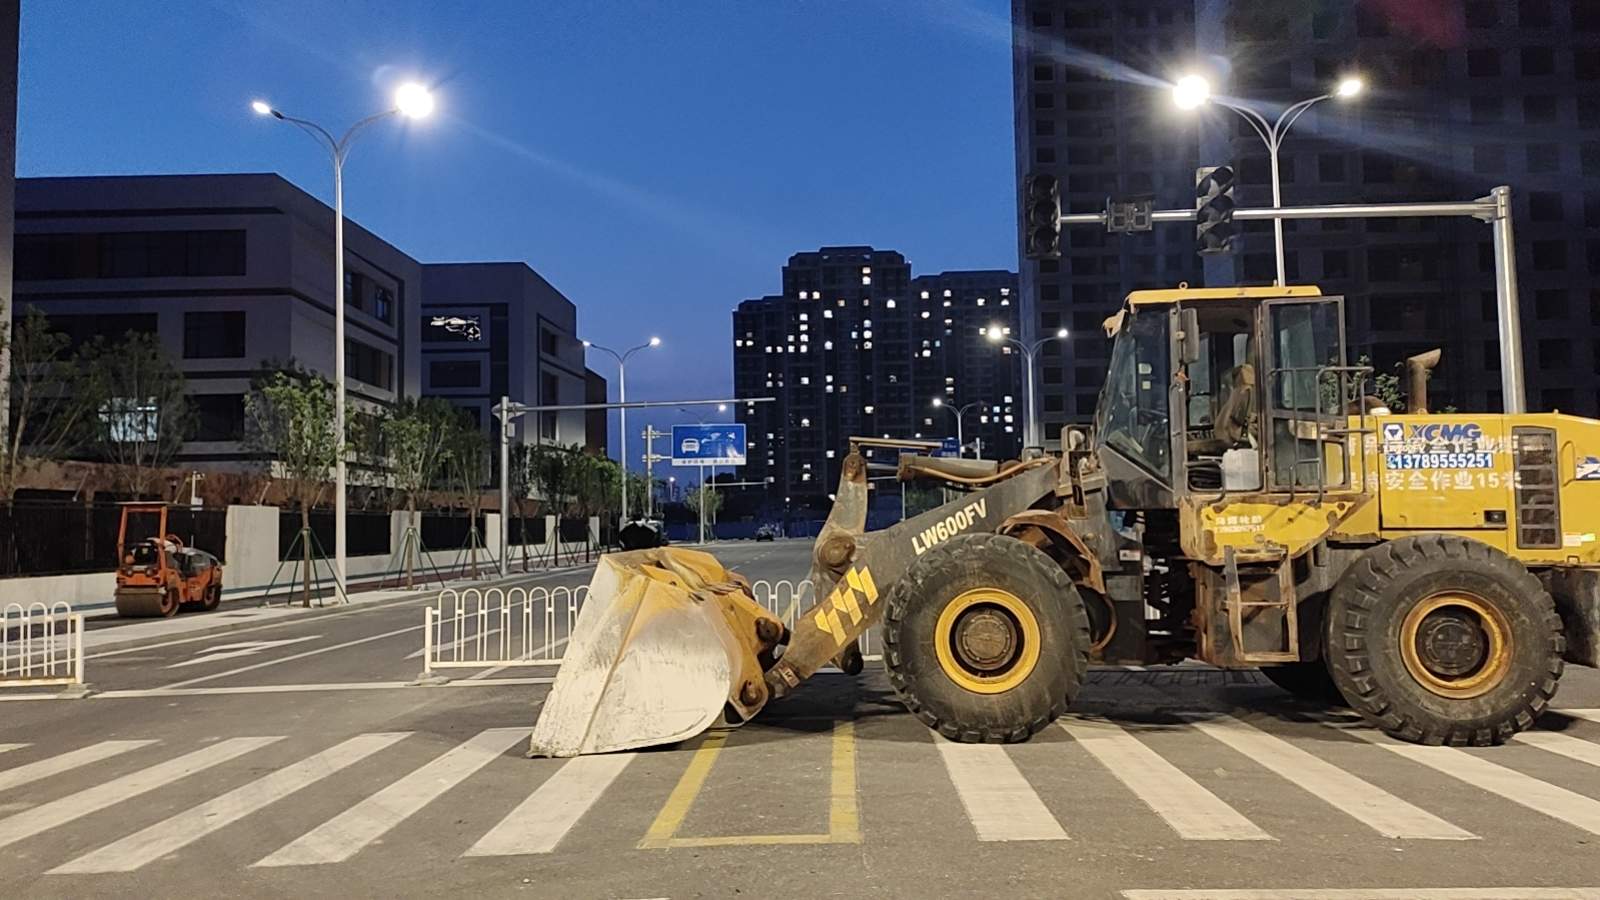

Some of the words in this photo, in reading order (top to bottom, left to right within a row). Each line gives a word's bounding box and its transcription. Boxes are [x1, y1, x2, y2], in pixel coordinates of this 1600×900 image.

[1410, 423, 1482, 442] XCMG
[1395, 453, 1493, 468] 13789555251
[911, 498, 988, 556] LW600FV
